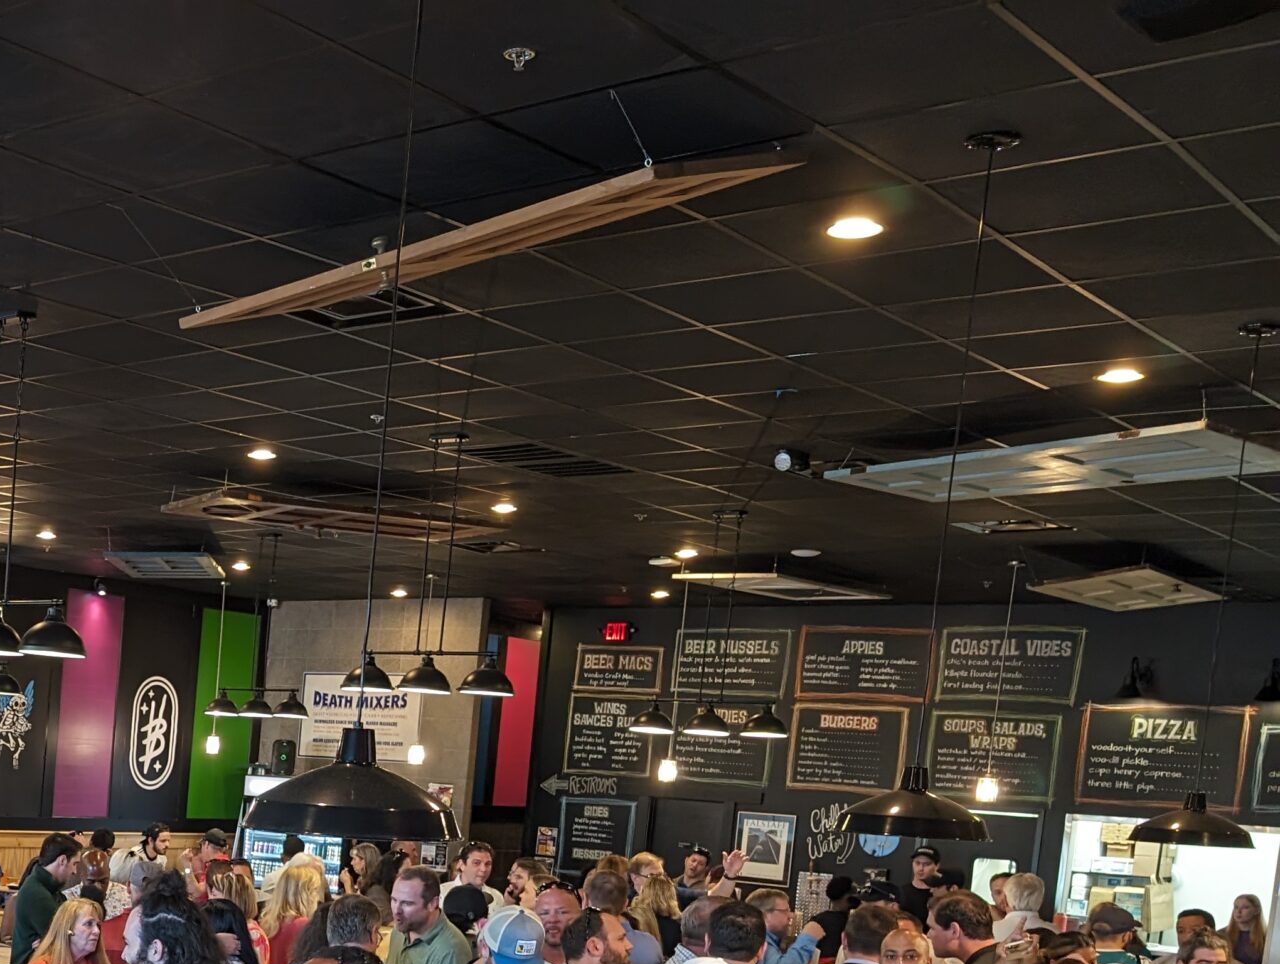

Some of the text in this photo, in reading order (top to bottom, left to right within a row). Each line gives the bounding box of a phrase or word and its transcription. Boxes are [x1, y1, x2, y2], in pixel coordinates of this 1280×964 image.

[606, 623, 627, 640] EXIT
[685, 639, 780, 655] BEER MUSSELS
[842, 640, 884, 655] APPIES
[951, 638, 1072, 656] COASTAL VIBES
[583, 654, 654, 671] BEER MACS
[313, 691, 408, 709] DEATH MIXERS
[594, 702, 627, 715] WINGS
[573, 714, 613, 727] SAWCES
[820, 714, 878, 730] BURGERS
[1132, 718, 1197, 741] PIZZA
[970, 735, 1017, 750] WRAPS
[1114, 768, 1140, 778] henry
[569, 776, 617, 795] RESTROOMS
[1088, 779, 1112, 788] three
[1115, 780, 1133, 789] little
[584, 805, 609, 817] SIDES
[745, 819, 787, 828] FALSTAFF
[807, 835, 843, 860] Water
